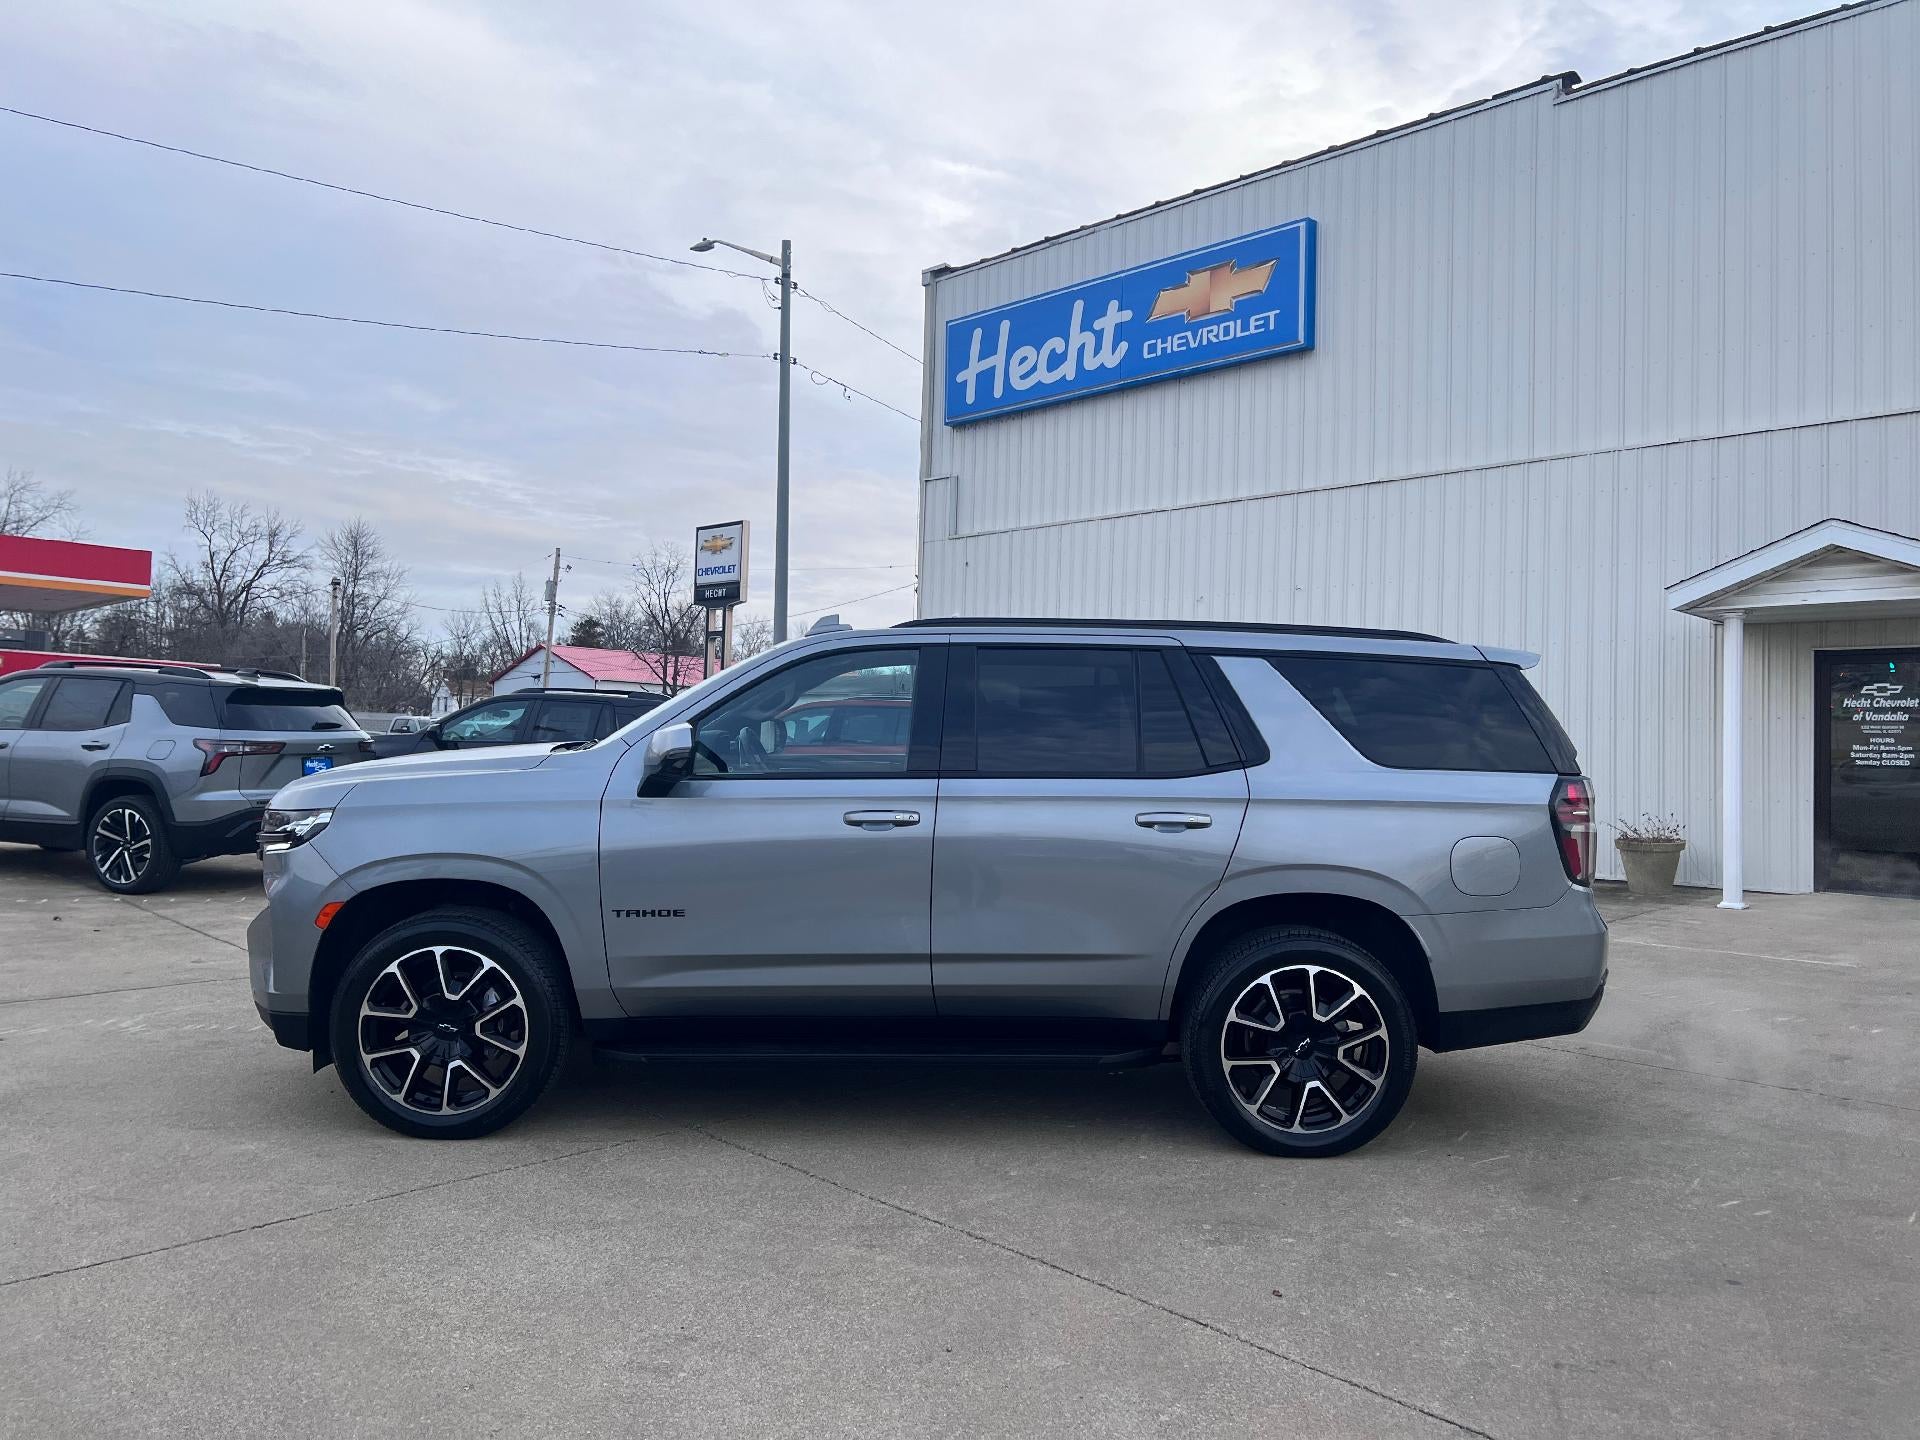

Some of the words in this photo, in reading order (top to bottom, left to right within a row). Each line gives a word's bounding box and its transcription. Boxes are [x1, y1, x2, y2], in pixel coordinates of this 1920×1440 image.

[1143, 309, 1280, 359] CHEVROLET
[956, 299, 1133, 405] Hecht
[697, 564, 736, 576] CHEVROLET
[705, 588, 726, 598] HECHT
[1843, 698, 1871, 707] Hecht
[1873, 698, 1919, 707] Chevrolet
[1853, 711, 1863, 721] of
[1865, 711, 1909, 721] Vandalia
[611, 909, 686, 918] TAHOE
